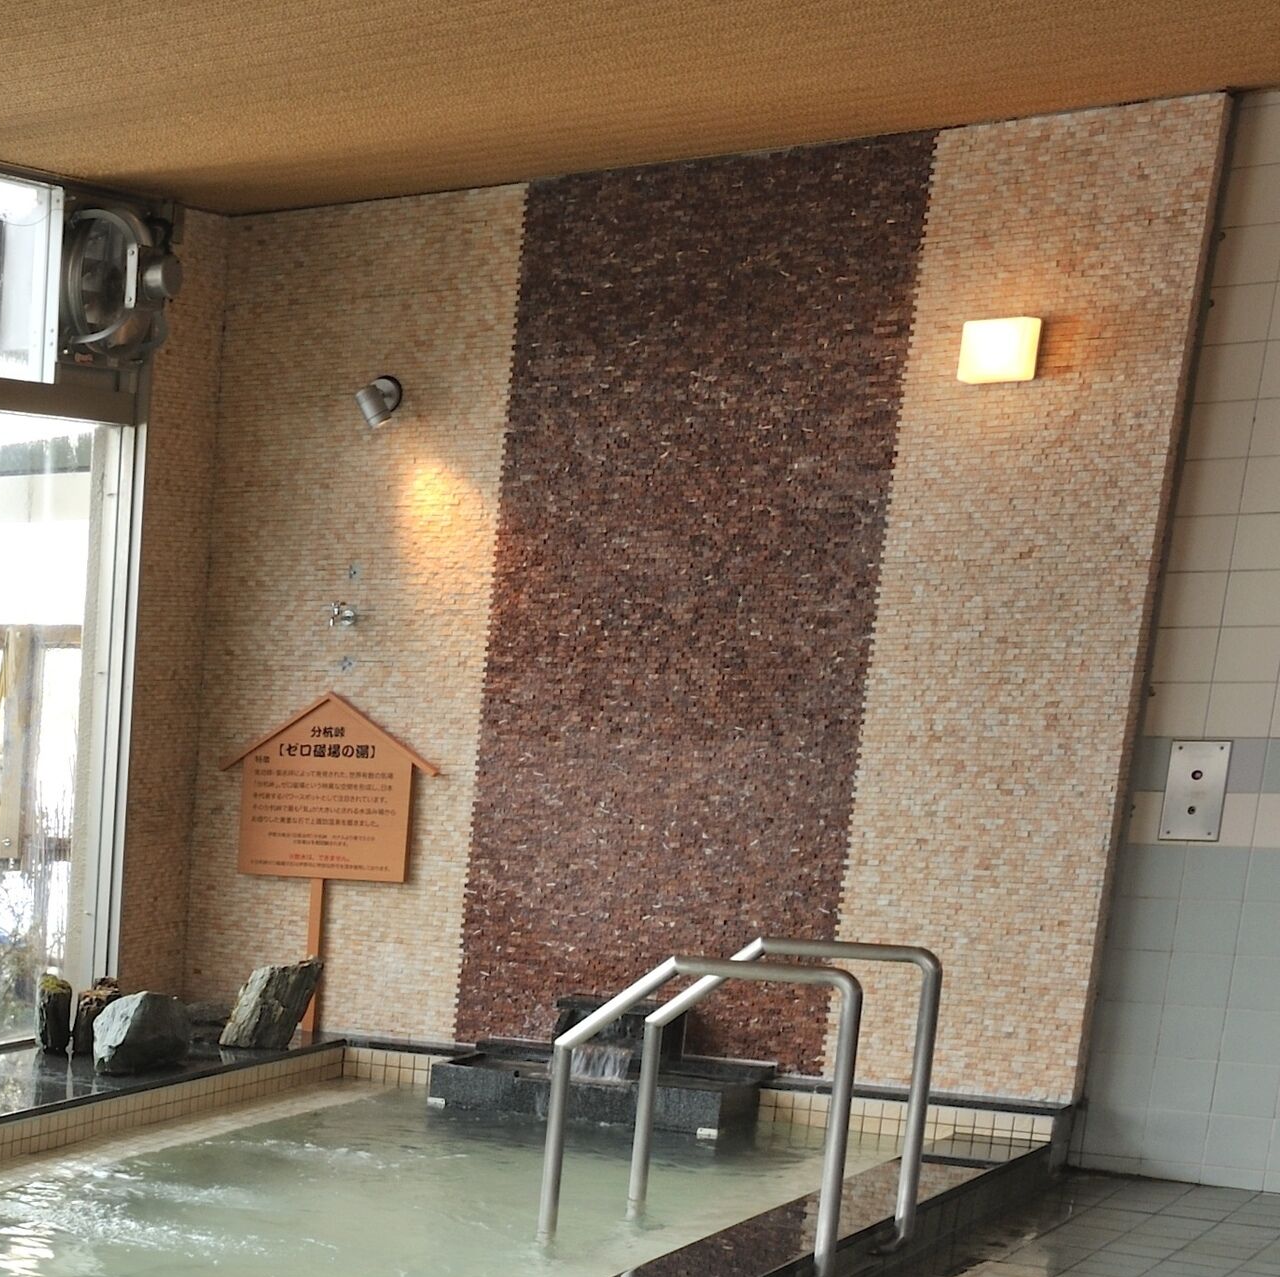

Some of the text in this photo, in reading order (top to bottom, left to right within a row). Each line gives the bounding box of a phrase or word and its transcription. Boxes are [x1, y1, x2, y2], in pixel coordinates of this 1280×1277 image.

[311, 726, 345, 738] 分杭峠
[279, 743, 376, 759] 【ゼロ磁場の湯】
